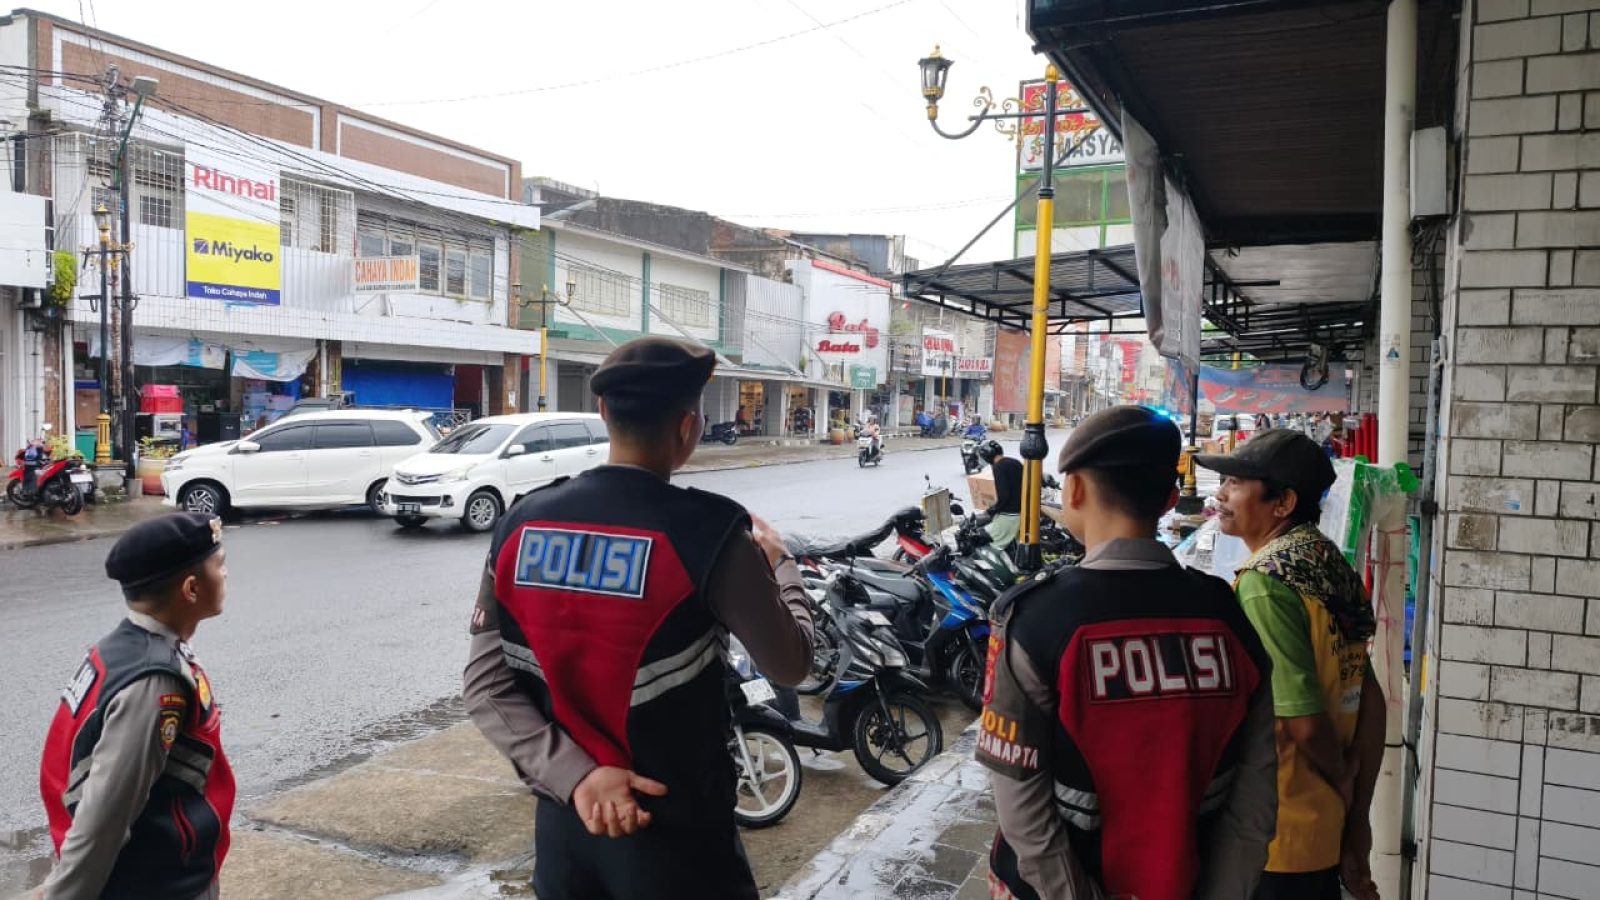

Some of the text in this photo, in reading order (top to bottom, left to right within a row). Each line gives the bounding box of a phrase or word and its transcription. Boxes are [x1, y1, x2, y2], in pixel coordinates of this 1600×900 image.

[194, 165, 275, 201] Rinnai
[211, 239, 273, 263] Miyako
[816, 339, 860, 353] Bata
[519, 533, 646, 592] POLISI
[1092, 635, 1231, 697] POLISI
